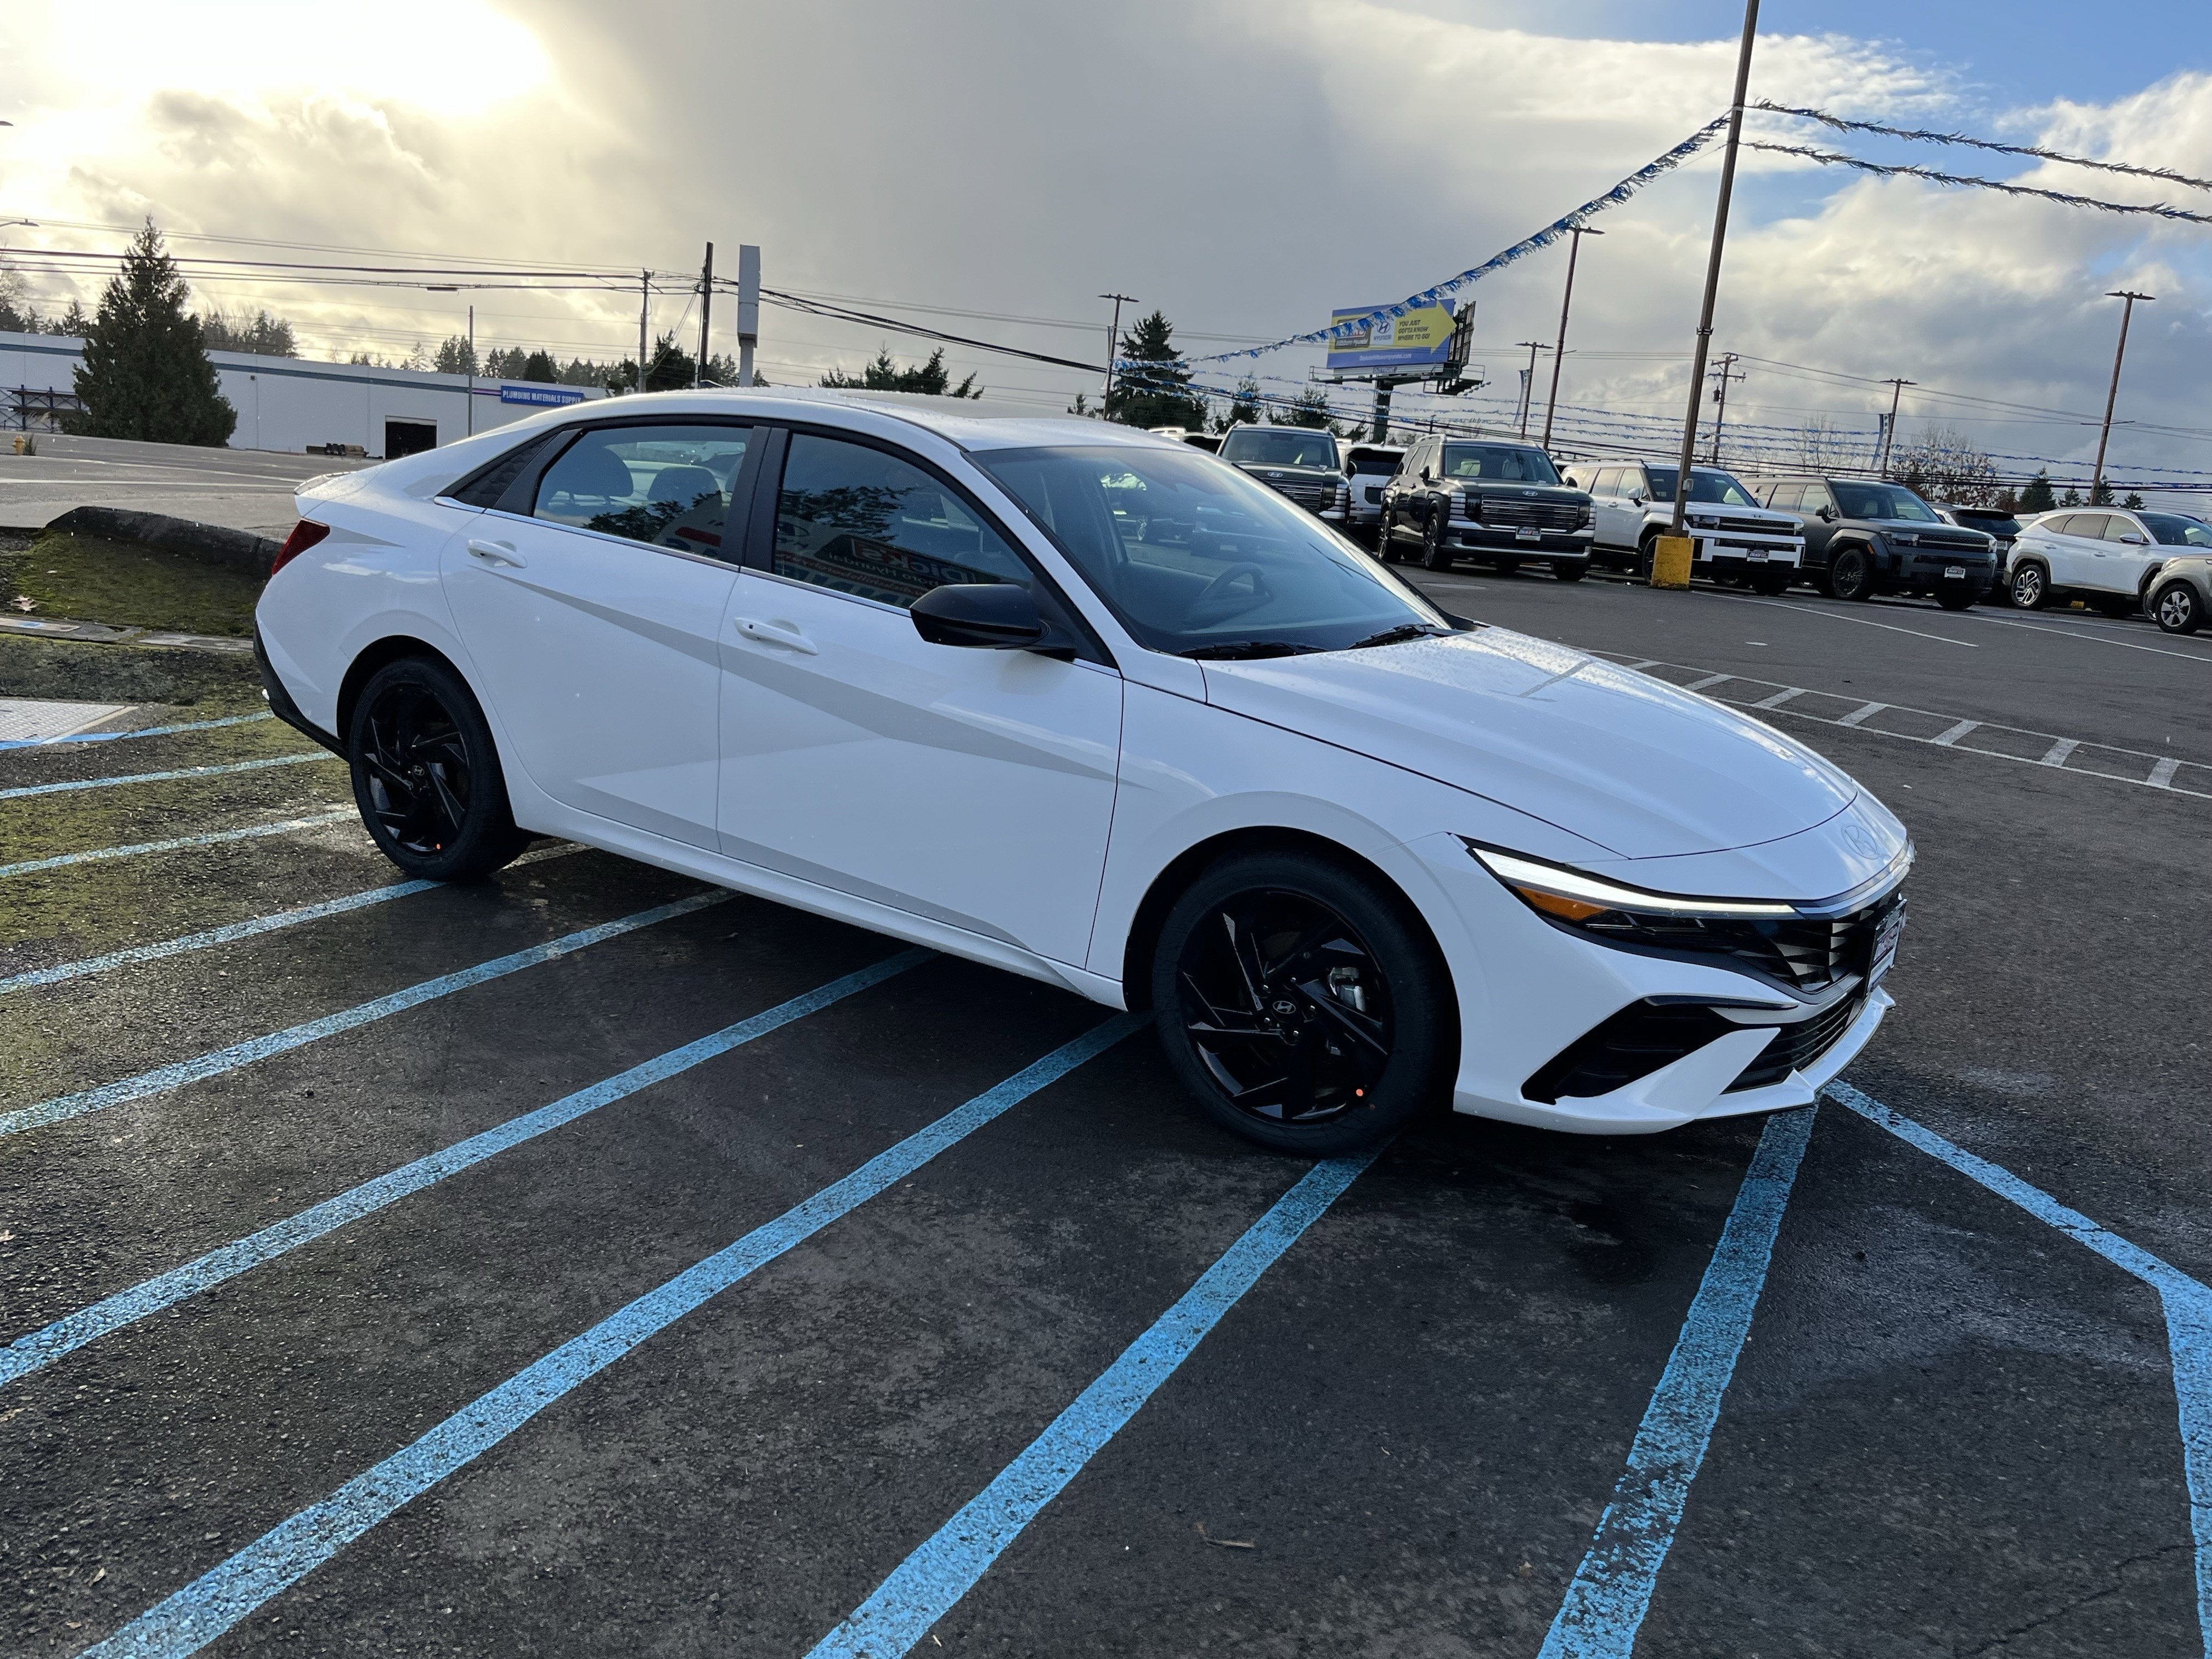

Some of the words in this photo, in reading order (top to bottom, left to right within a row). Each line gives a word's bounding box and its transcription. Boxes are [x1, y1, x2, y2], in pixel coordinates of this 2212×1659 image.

[503, 390, 531, 400] PLUMBING
[532, 393, 561, 403] MATERIALS
[561, 396, 582, 404] SUPPLY
